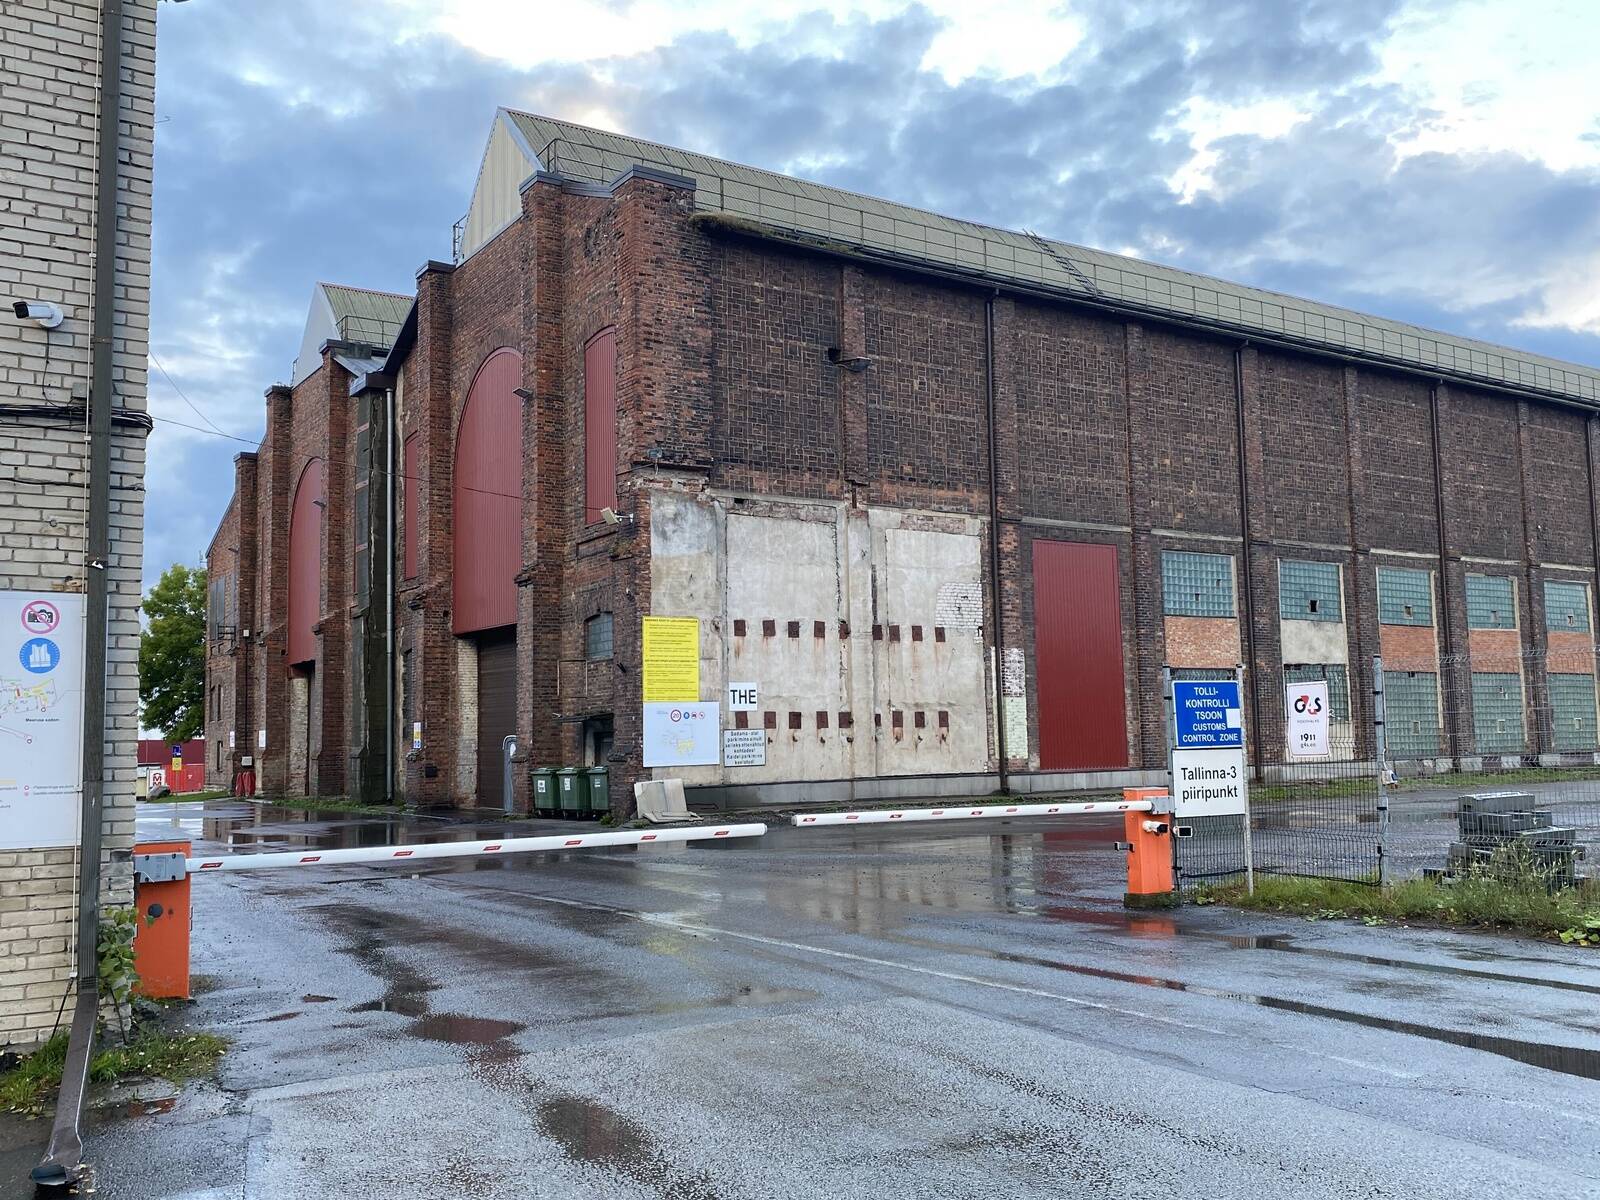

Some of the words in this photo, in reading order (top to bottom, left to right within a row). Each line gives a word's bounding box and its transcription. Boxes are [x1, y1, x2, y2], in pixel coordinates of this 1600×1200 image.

[1194, 687, 1218, 696] TOLLI-
[730, 690, 756, 704] THE
[1185, 698, 1230, 708] KONTROLLI
[1294, 695, 1322, 715] G4S
[1195, 711, 1223, 720] TSOON
[1192, 722, 1226, 732] CUSTOMS
[1182, 734, 1217, 742] CONTROL
[1219, 733, 1239, 741] ZONE
[1300, 733, 1316, 741] 1911
[1181, 766, 1237, 781] Tallinna-3
[1182, 785, 1238, 802] piiripunkt
